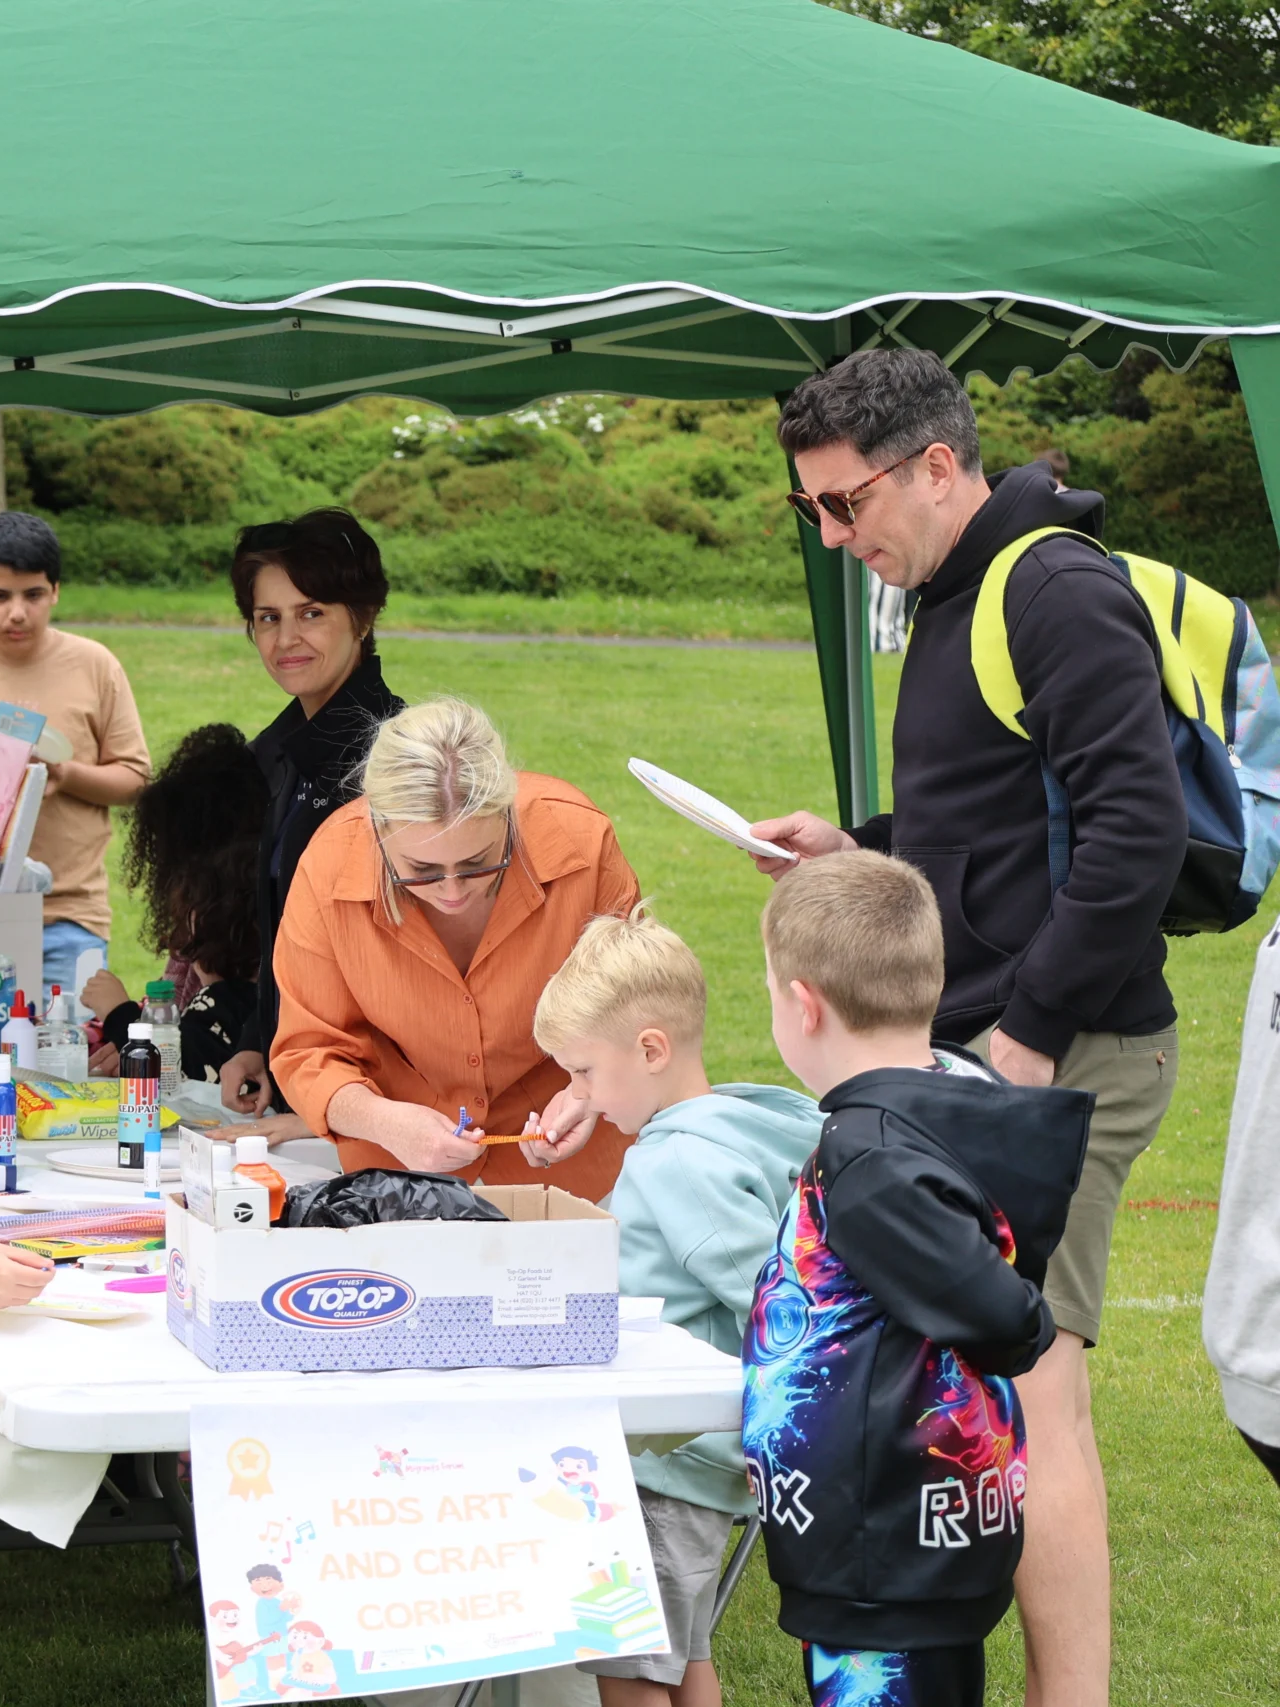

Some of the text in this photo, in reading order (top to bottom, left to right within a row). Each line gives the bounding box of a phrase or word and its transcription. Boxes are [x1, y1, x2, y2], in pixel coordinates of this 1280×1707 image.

[137, 1104, 160, 1113] PAIN
[80, 1125, 118, 1139] Wipe
[333, 1310, 368, 1318] QUALITY
[331, 1492, 513, 1528] KIDS ART
[318, 1539, 545, 1581] AND CRAFT
[356, 1590, 525, 1631] CORNER
